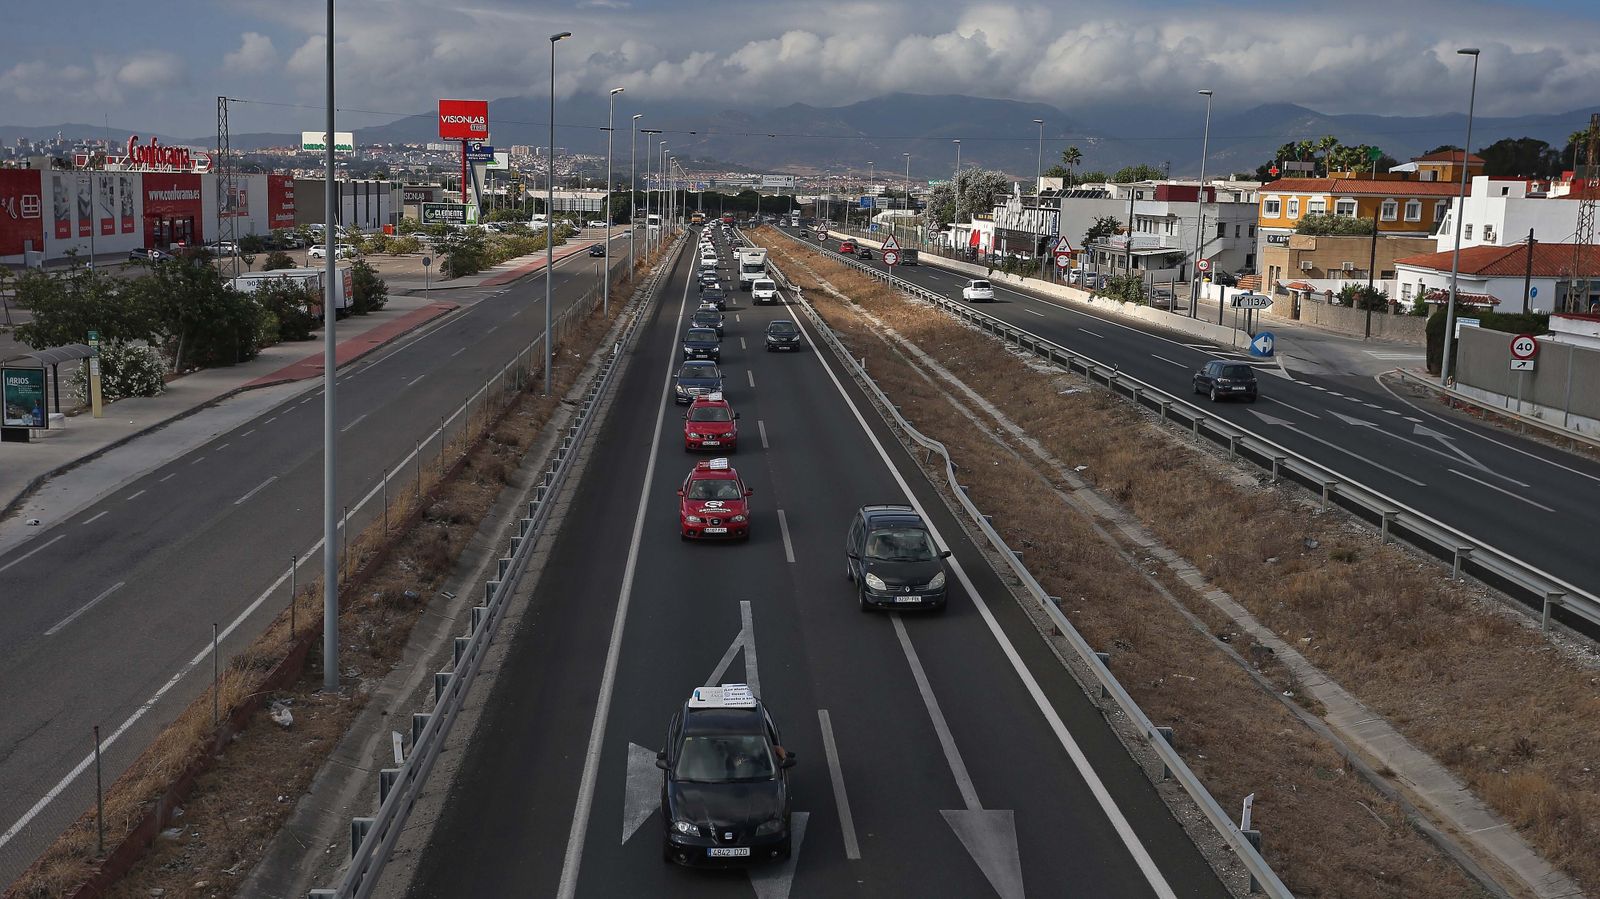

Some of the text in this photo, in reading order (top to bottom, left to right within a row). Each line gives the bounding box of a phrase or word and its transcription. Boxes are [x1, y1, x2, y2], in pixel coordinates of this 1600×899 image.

[441, 115, 485, 124] VISIONLAB
[128, 135, 190, 168] Conforama
[148, 184, 200, 201] www.conforama.es
[1516, 343, 1532, 351] 40
[6, 377, 30, 386] LARIOS
